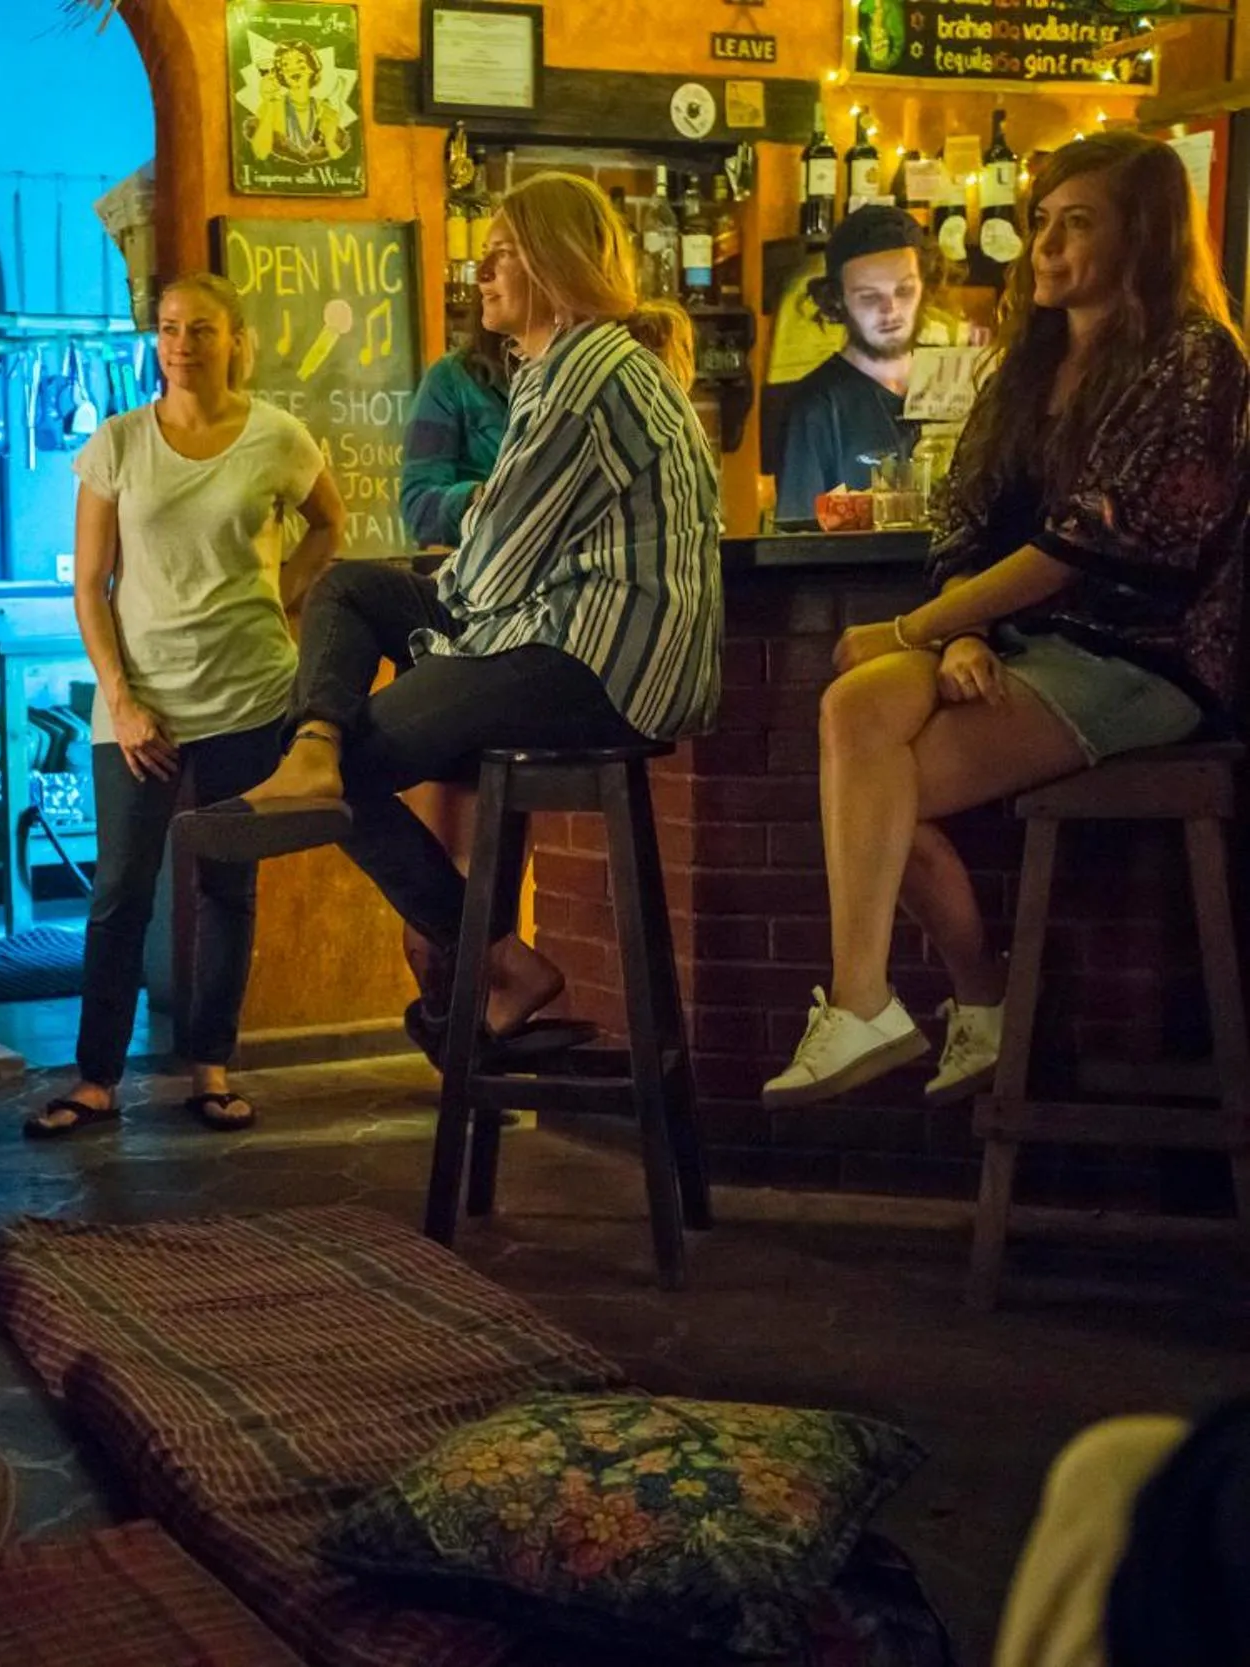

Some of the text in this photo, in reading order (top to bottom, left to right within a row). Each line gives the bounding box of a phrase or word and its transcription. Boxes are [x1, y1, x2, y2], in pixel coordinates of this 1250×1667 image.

[714, 37, 775, 60] LEAVE
[935, 44, 992, 74] tequila
[226, 228, 403, 297] OPEN MIC
[329, 389, 412, 427] SHOT
